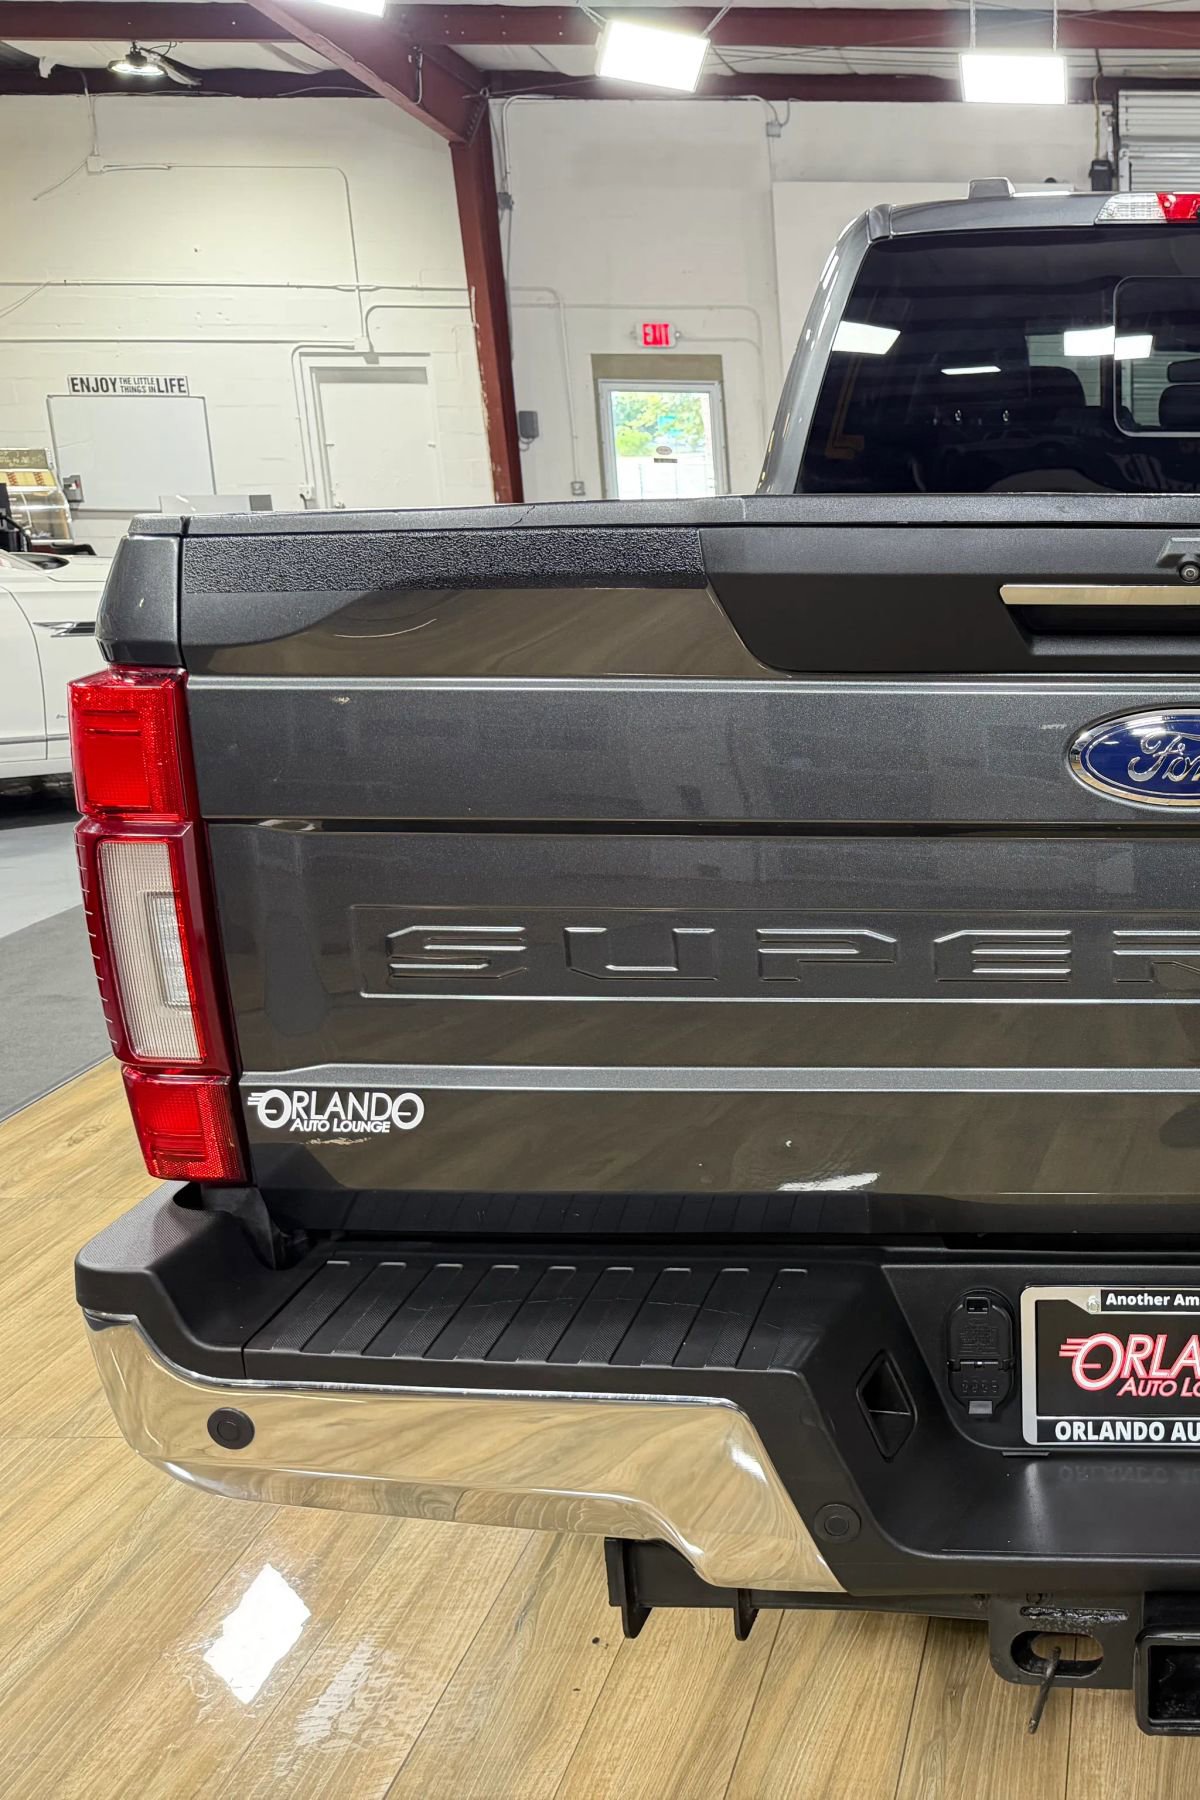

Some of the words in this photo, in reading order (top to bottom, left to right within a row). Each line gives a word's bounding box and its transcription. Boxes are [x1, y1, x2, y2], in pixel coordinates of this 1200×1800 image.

[641, 323, 669, 346] EXIT
[70, 377, 117, 393] ENJOY
[119, 377, 132, 385] THE
[133, 377, 156, 385] LITTLE
[156, 378, 187, 393] LIFE
[120, 385, 146, 393] THINGS
[148, 385, 156, 393] IN
[250, 1089, 425, 1130] ORLANDO
[1105, 1292, 1171, 1306] Another
[1054, 1420, 1165, 1441] ORLANDO
